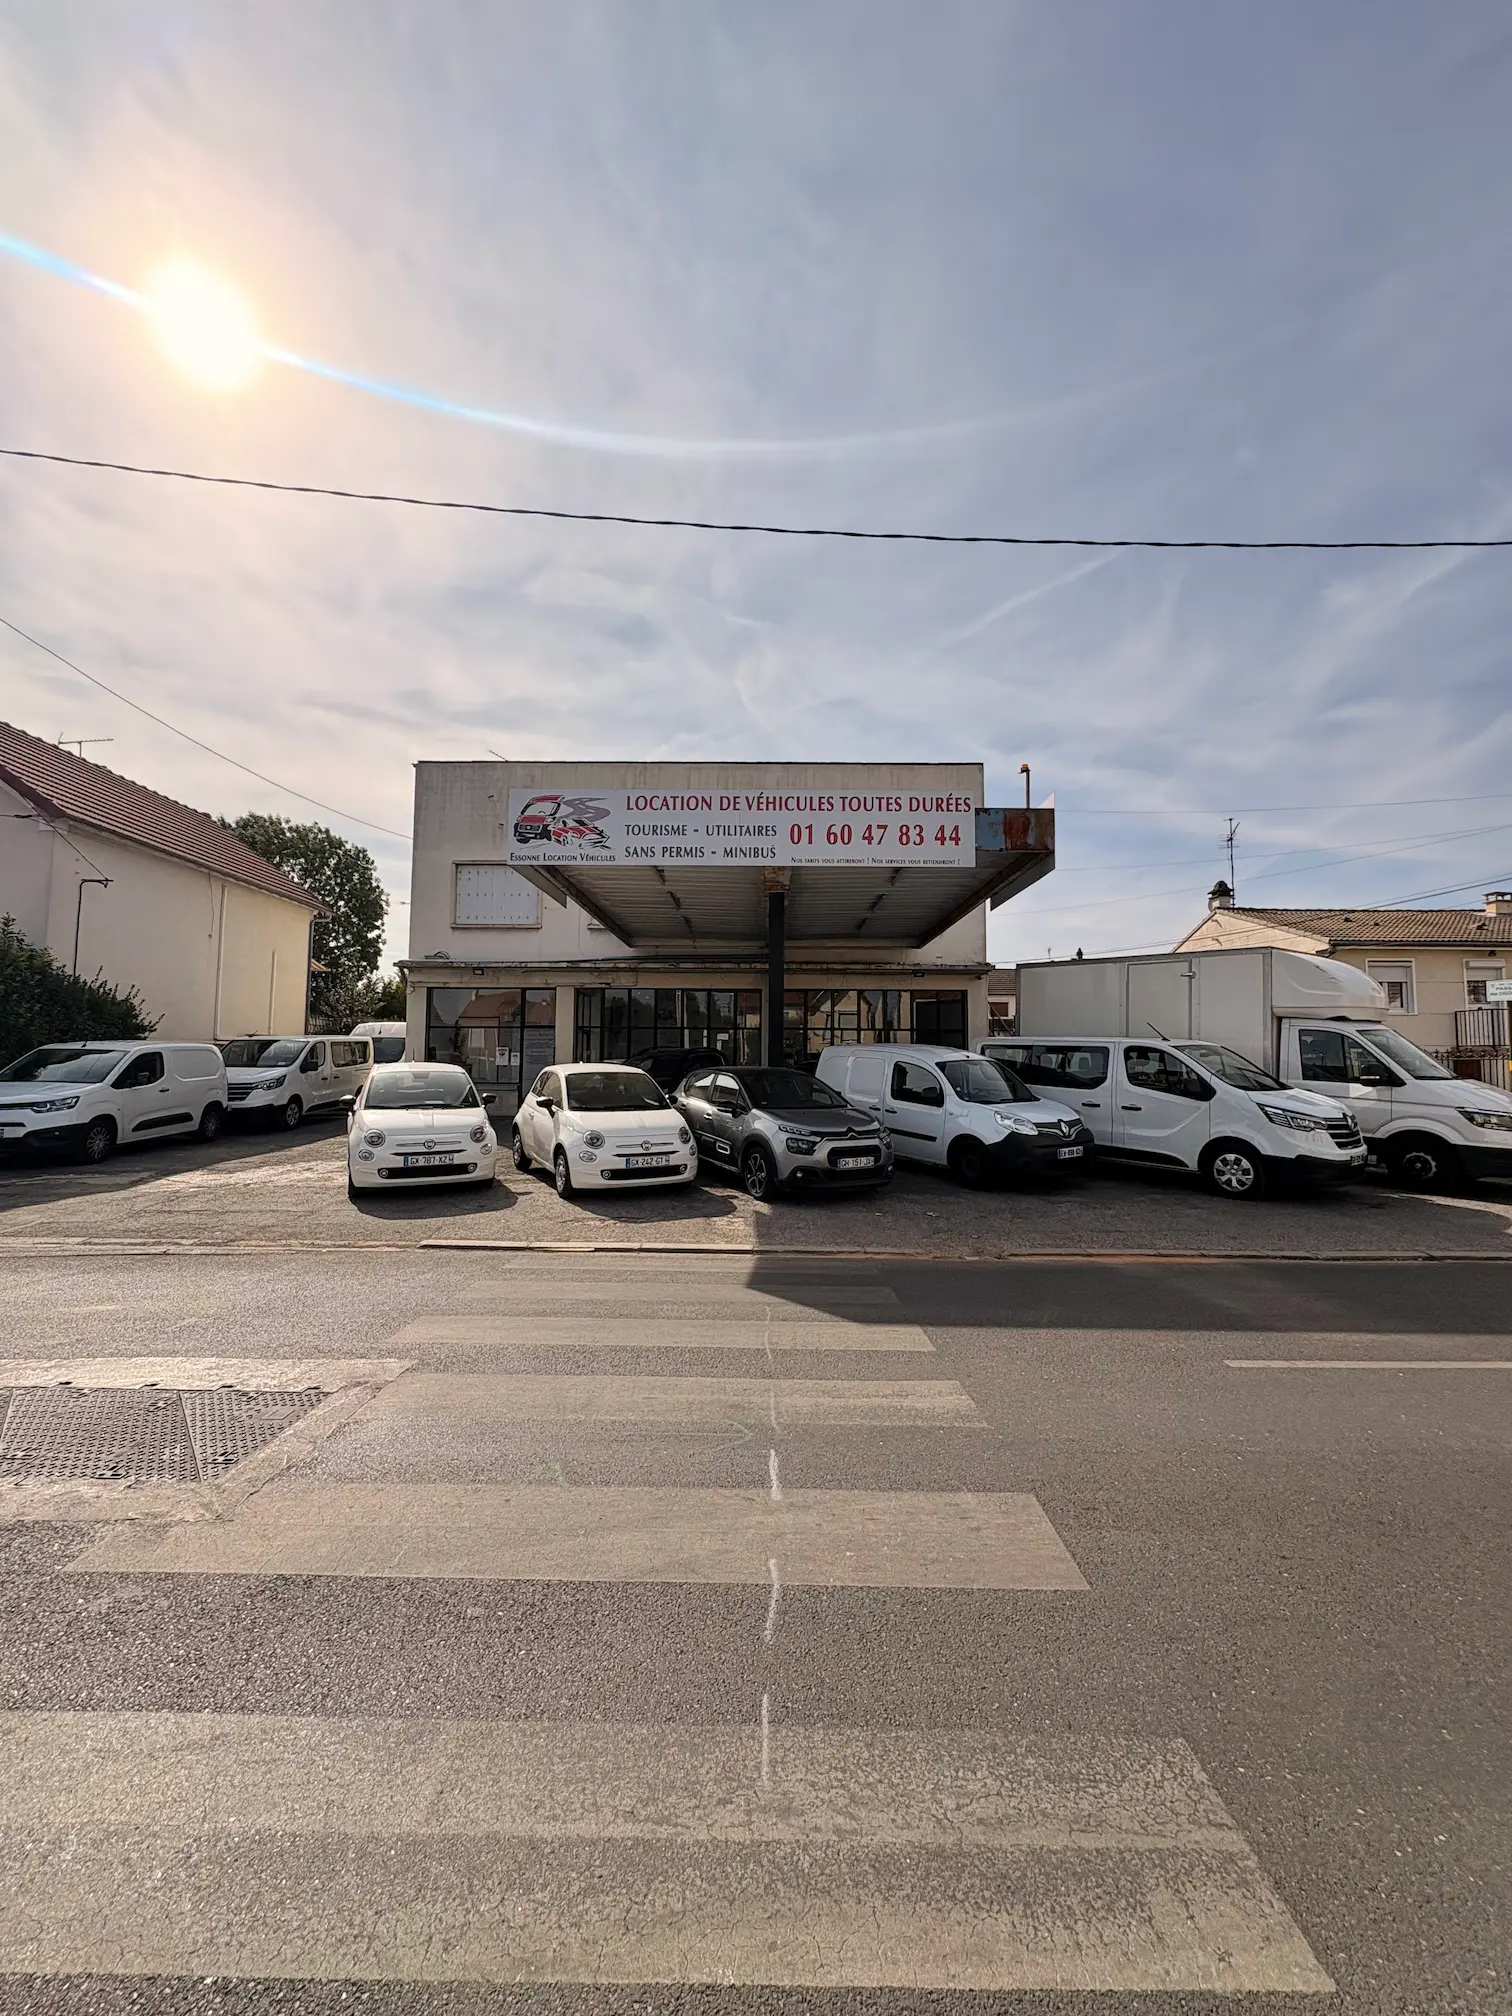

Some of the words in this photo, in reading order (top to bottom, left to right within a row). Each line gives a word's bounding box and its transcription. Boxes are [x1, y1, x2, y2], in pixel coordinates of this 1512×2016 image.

[626, 795, 712, 811] LOCATION
[719, 796, 741, 811] DE
[744, 792, 834, 812] VÉHICULES
[839, 796, 903, 812] TOUTES
[908, 793, 972, 813] DURÉES
[625, 824, 688, 836] TOURISME
[706, 824, 777, 837] UTILITAIRES
[789, 823, 814, 845] 01
[826, 824, 852, 845] 60
[862, 824, 888, 846] 47
[898, 824, 925, 846] 83
[934, 824, 961, 846] 44
[624, 846, 656, 858] SANS
[662, 846, 705, 858] PERMIS
[723, 846, 776, 859] MINIBUS
[410, 1156, 448, 1165] GX-787-XZ
[631, 1157, 664, 1166] GX-242-GT
